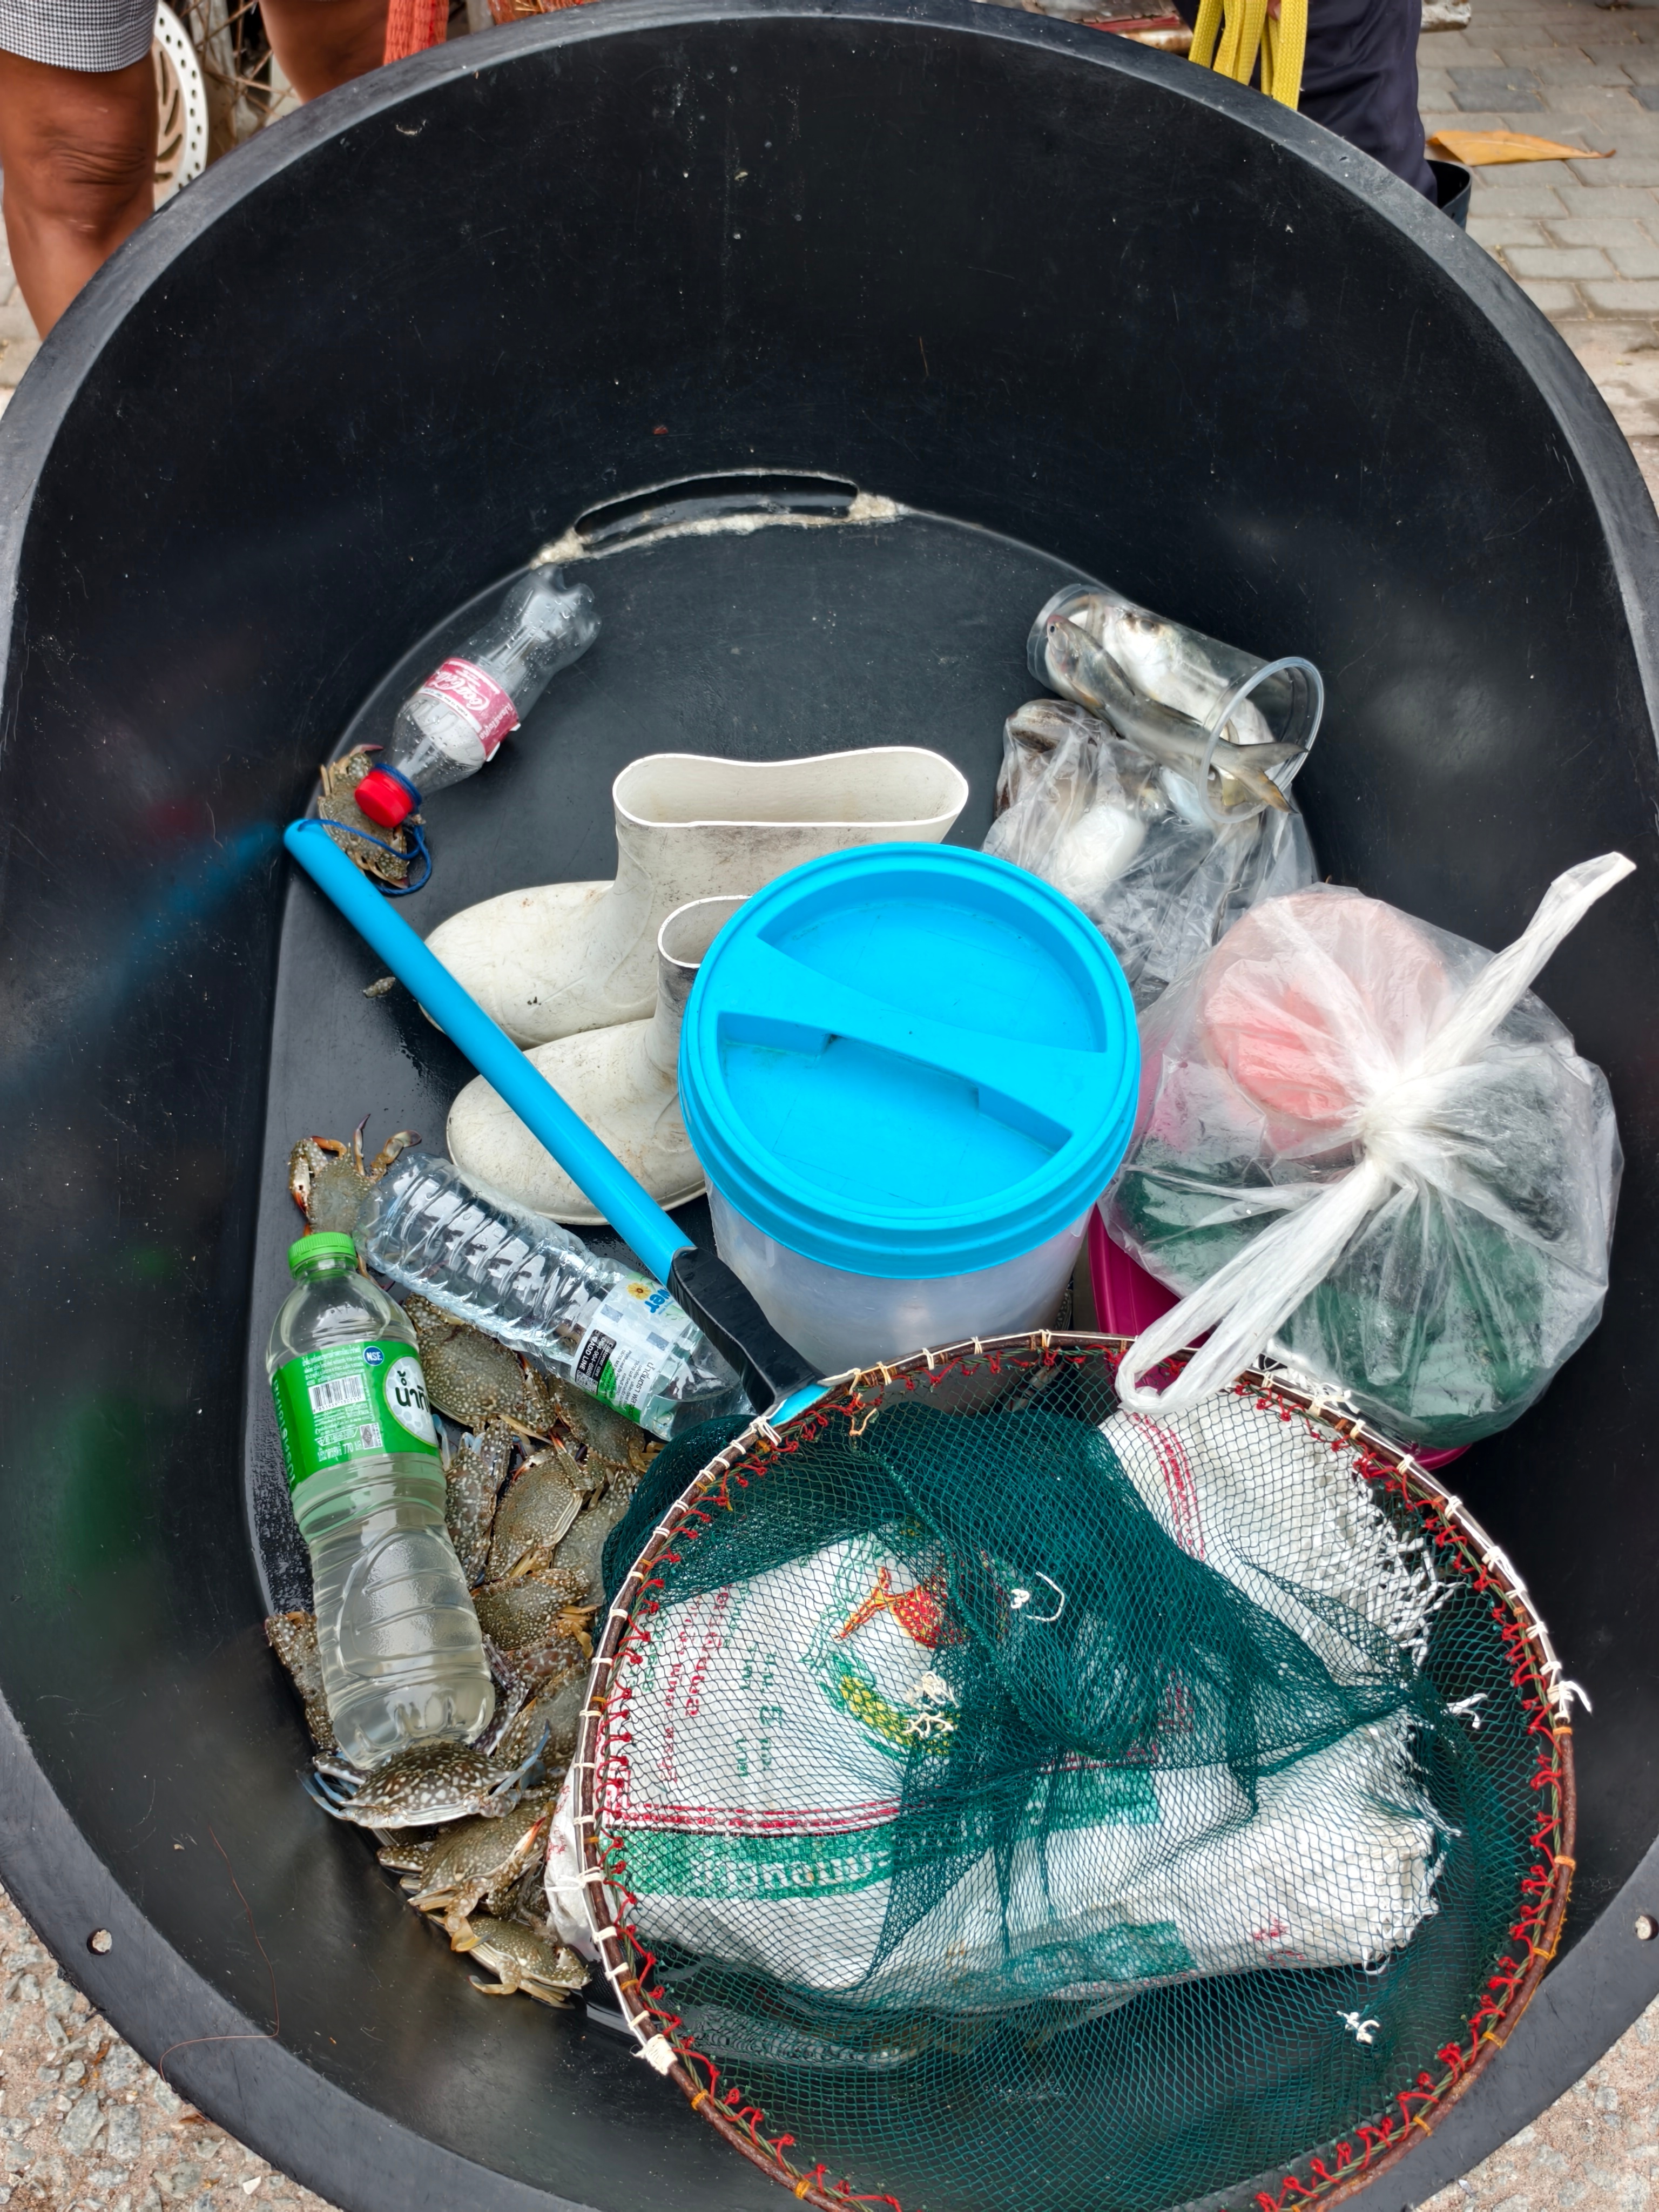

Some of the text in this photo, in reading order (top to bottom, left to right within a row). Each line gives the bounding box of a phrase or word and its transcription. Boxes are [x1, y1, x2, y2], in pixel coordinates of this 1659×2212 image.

[579, 1336, 598, 1371] @ADD LINE
[599, 1343, 613, 1366] Customer
[343, 1442, 354, 1454] 770
